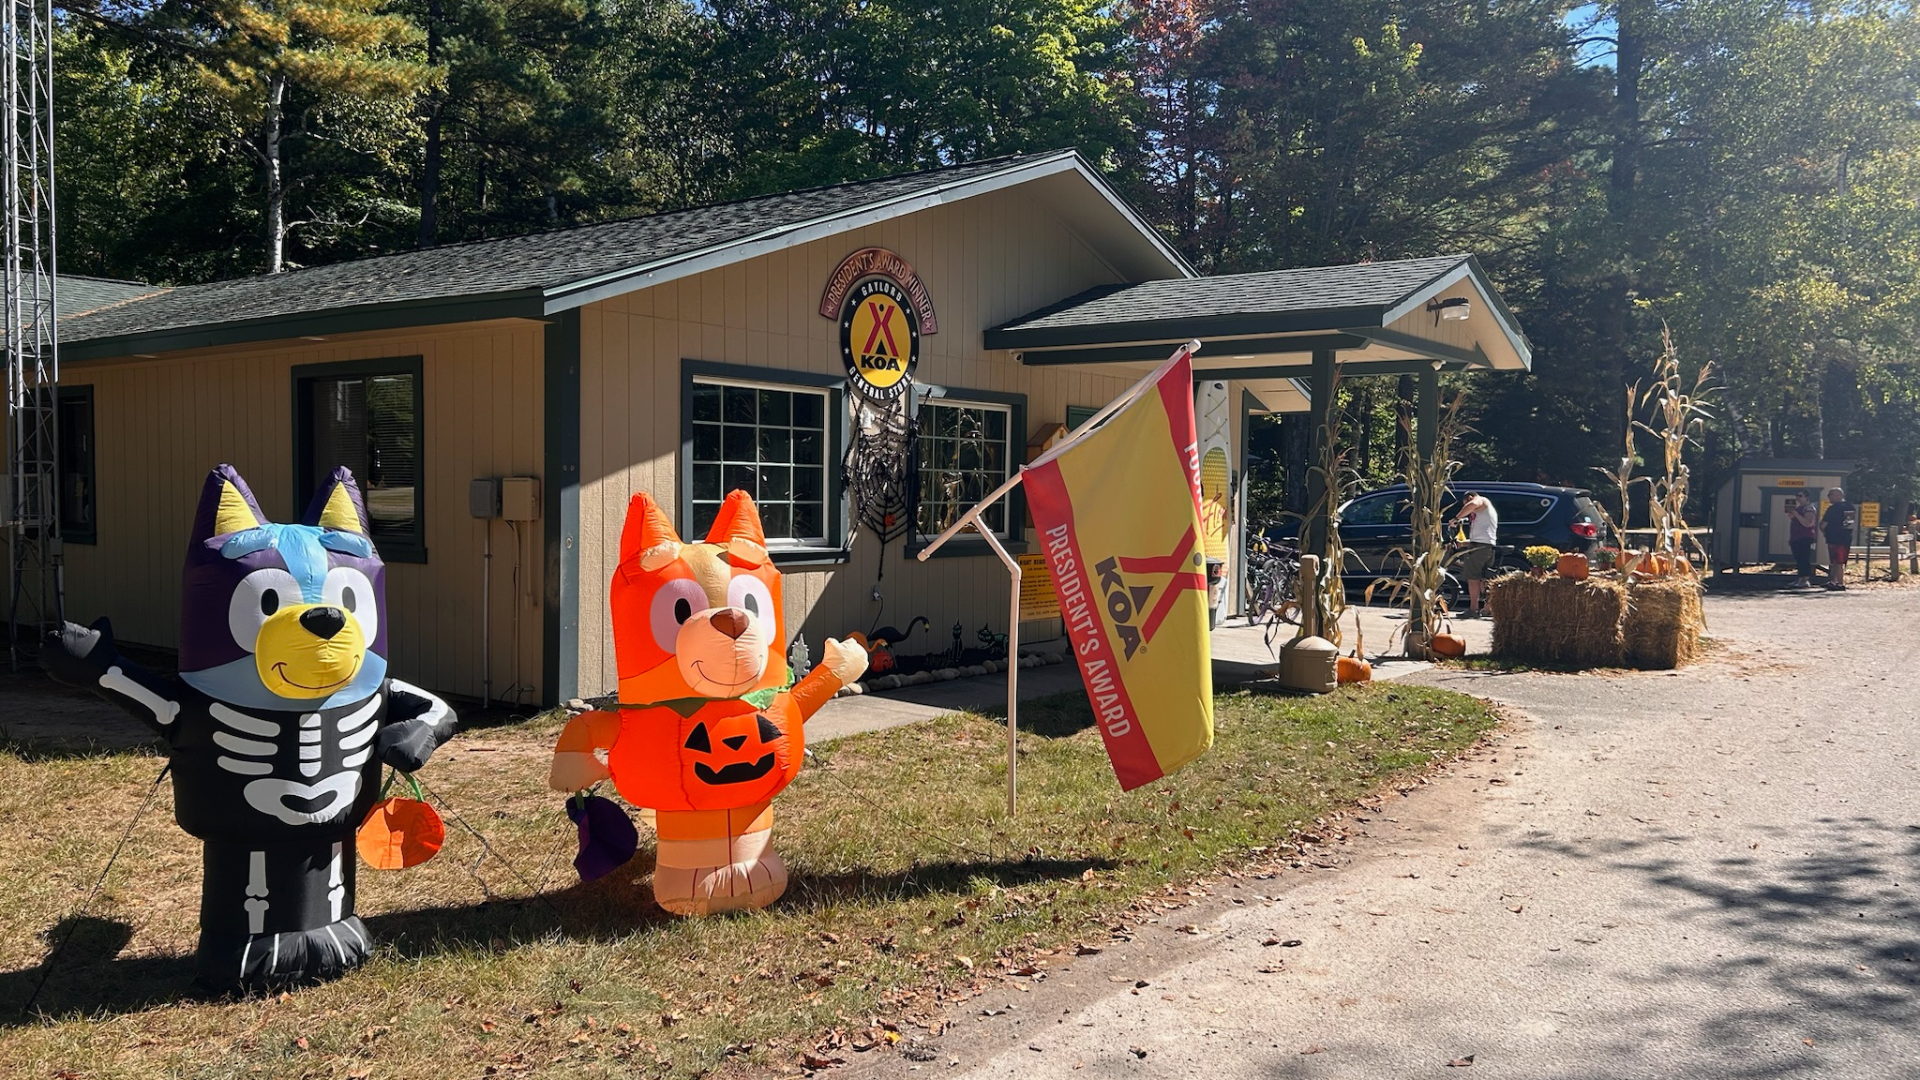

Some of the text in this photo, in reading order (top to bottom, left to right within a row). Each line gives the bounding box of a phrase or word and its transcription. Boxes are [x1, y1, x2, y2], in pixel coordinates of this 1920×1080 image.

[828, 253, 932, 321] PRESIDENT'S AWARD WINNER
[861, 281, 902, 302] GAYLORD
[849, 366, 912, 400] GENERAL STORE
[861, 354, 901, 372] KOA
[1045, 523, 1131, 738] PRESIDENT'S AWARD
[1094, 555, 1142, 663] KOA
